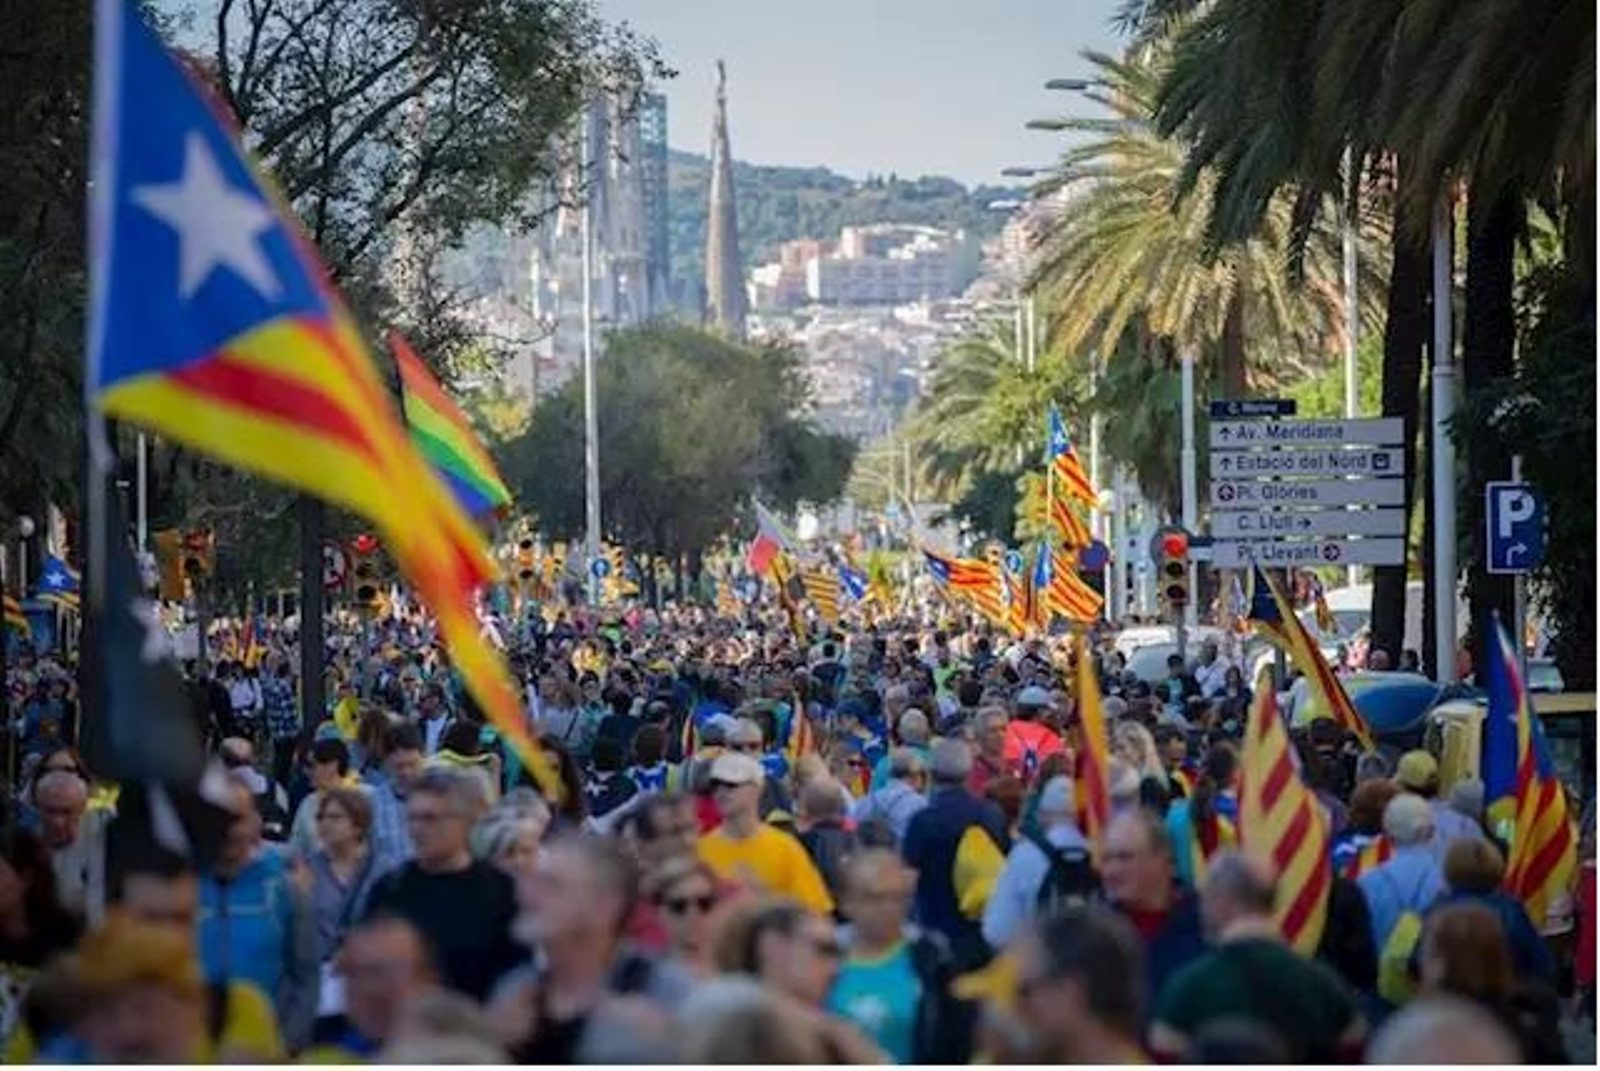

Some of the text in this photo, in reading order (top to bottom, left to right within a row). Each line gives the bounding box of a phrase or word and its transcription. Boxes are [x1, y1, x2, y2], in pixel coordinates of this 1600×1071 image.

[1237, 425, 1344, 439] Av. Meridiana
[1299, 455, 1323, 470] del
[1329, 454, 1366, 469] Nord
[1499, 490, 1535, 538] P
[1237, 515, 1293, 530] C. Llull
[1262, 545, 1318, 560] Llevant
